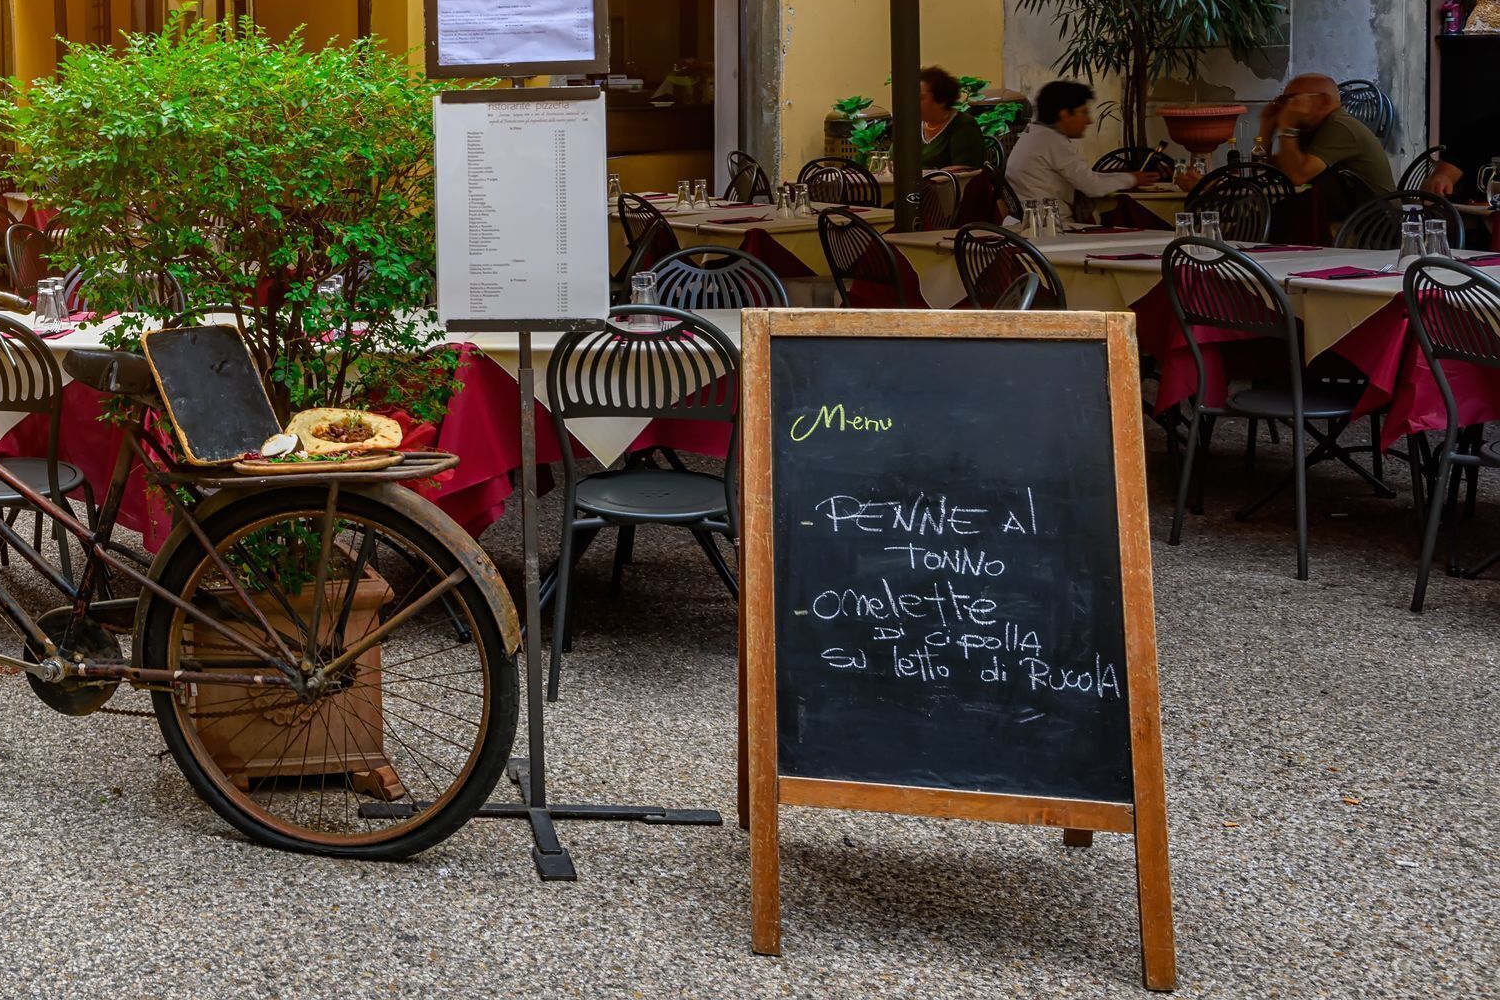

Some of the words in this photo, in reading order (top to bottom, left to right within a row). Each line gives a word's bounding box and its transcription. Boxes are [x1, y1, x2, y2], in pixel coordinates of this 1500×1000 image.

[791, 404, 892, 441] Menu
[816, 492, 988, 535] PENNE
[980, 656, 1008, 682] di
